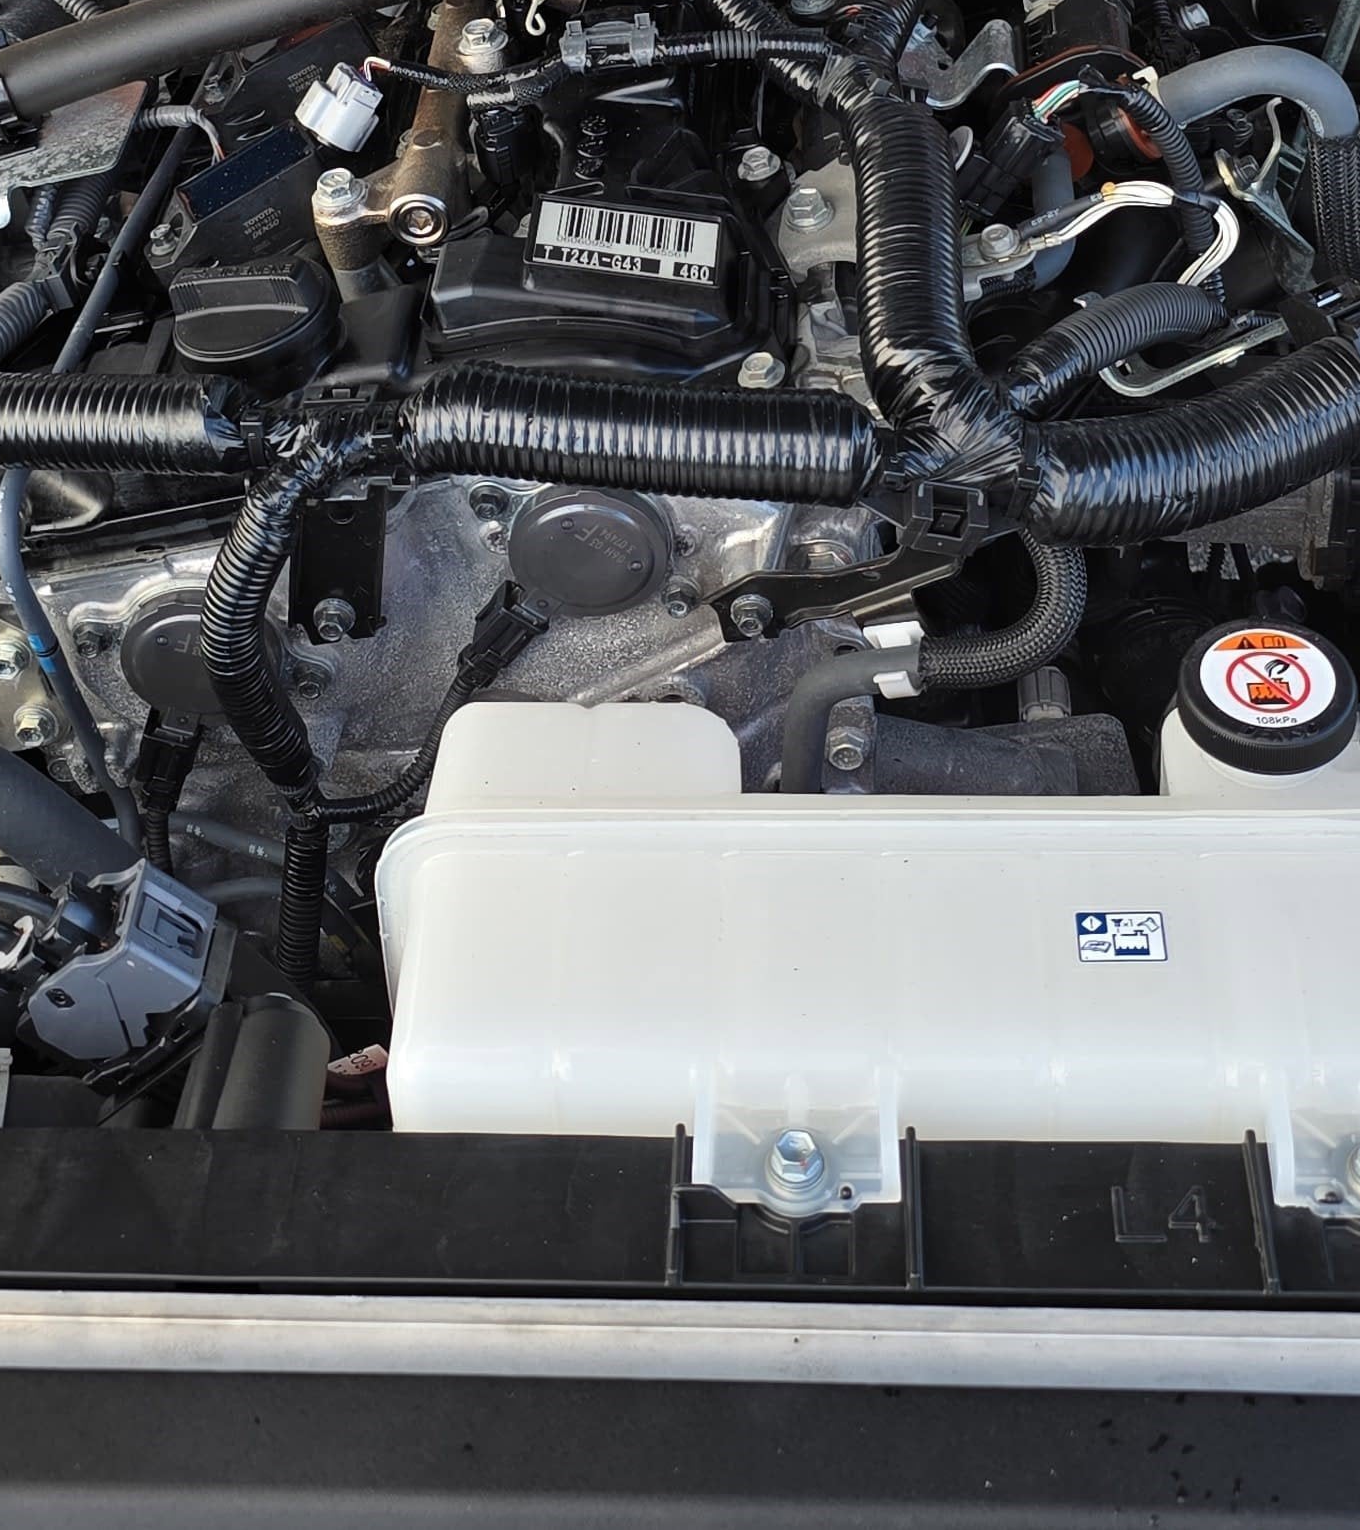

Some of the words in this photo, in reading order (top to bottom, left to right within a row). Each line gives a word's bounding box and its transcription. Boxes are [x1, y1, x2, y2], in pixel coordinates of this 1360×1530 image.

[287, 64, 317, 81] TOYOTA
[243, 207, 274, 228] TOYOTA
[252, 219, 280, 239] DENSO
[543, 245, 554, 260] T
[561, 248, 641, 271] T24A-G43
[679, 263, 710, 281] 460
[574, 524, 599, 542] F
[173, 633, 191, 653] F
[1256, 716, 1298, 725] 108kPa
